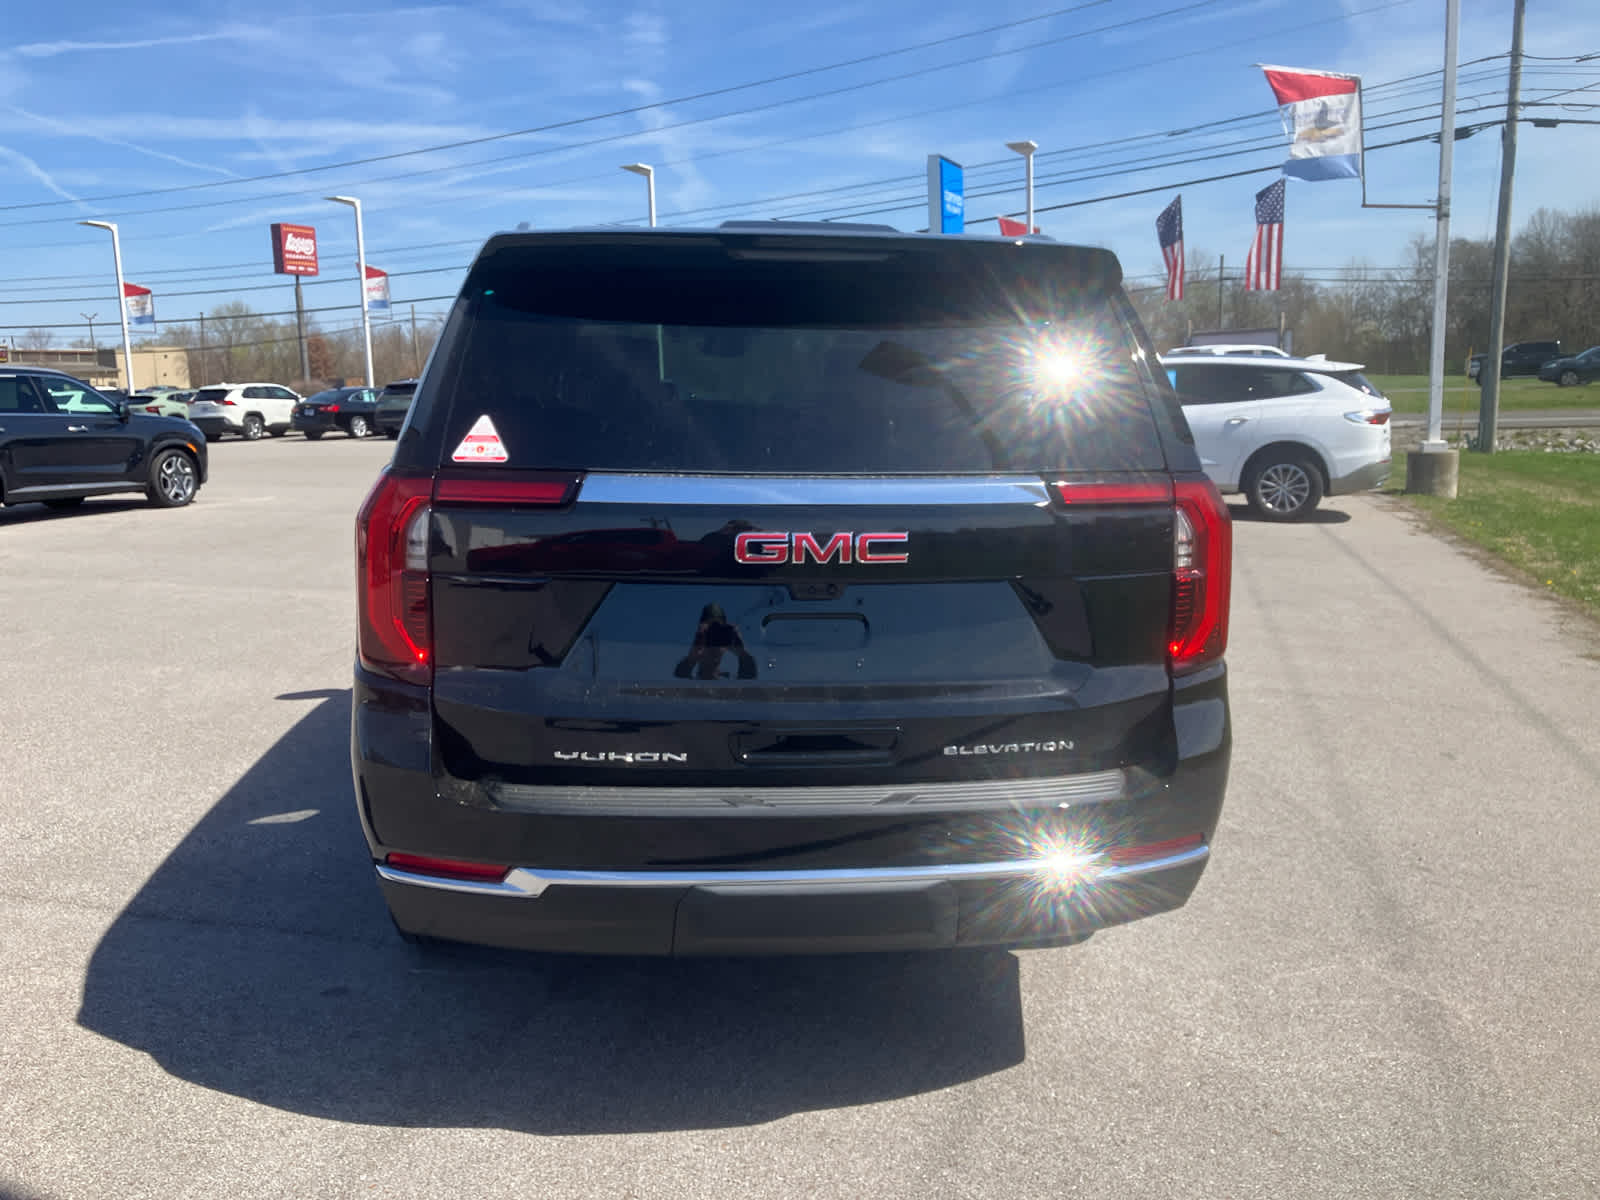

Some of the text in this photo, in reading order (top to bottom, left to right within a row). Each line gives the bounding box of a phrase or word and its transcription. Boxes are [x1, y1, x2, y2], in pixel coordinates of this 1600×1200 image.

[734, 530, 910, 565] GMC
[943, 740, 1075, 755] ELEVATION
[553, 750, 688, 762] YUKON
